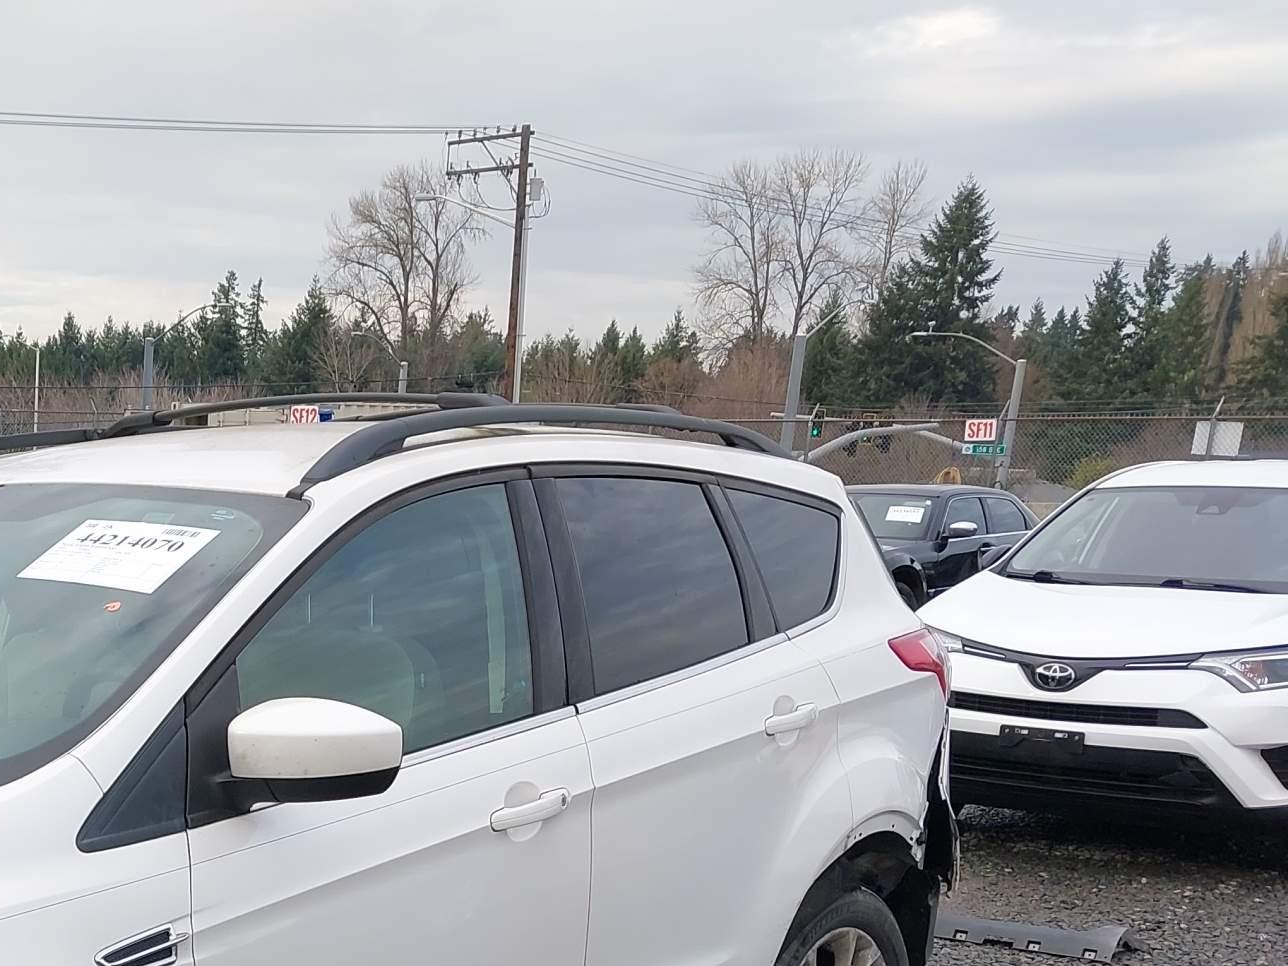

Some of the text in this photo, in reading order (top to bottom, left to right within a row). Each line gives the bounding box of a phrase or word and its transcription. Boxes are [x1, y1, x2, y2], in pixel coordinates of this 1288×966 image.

[292, 407, 317, 424] SF12
[967, 421, 993, 438] SF11
[76, 532, 185, 553] 44214070
